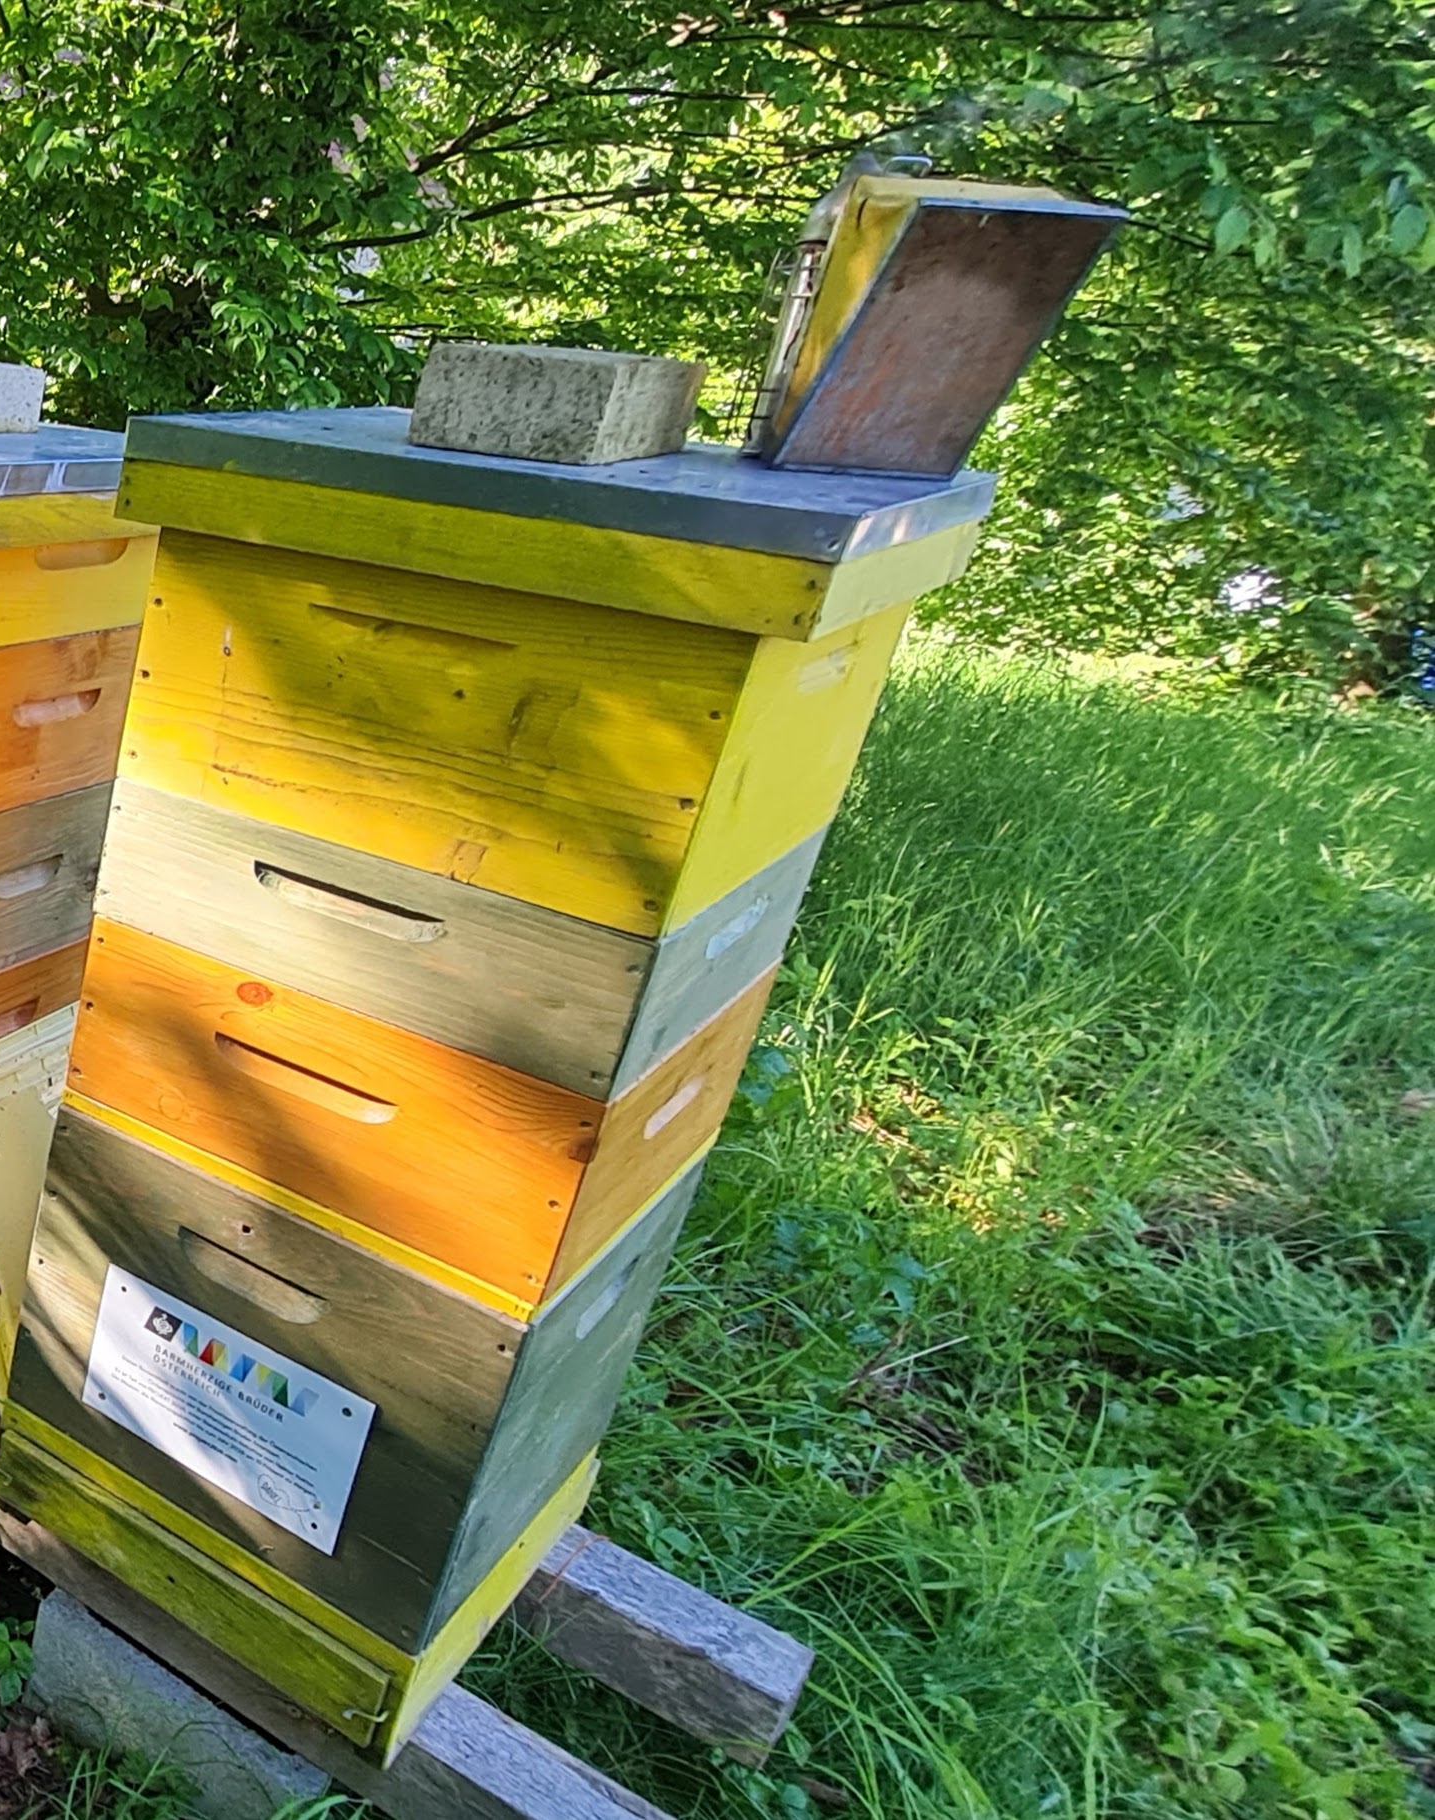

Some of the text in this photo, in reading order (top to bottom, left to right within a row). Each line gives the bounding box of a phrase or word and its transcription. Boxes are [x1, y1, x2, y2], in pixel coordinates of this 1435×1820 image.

[153, 1353, 221, 1398] ÖSTERREICH
[155, 1344, 233, 1394] BARMHERZIGE
[237, 1391, 284, 1423] BRÜDER
